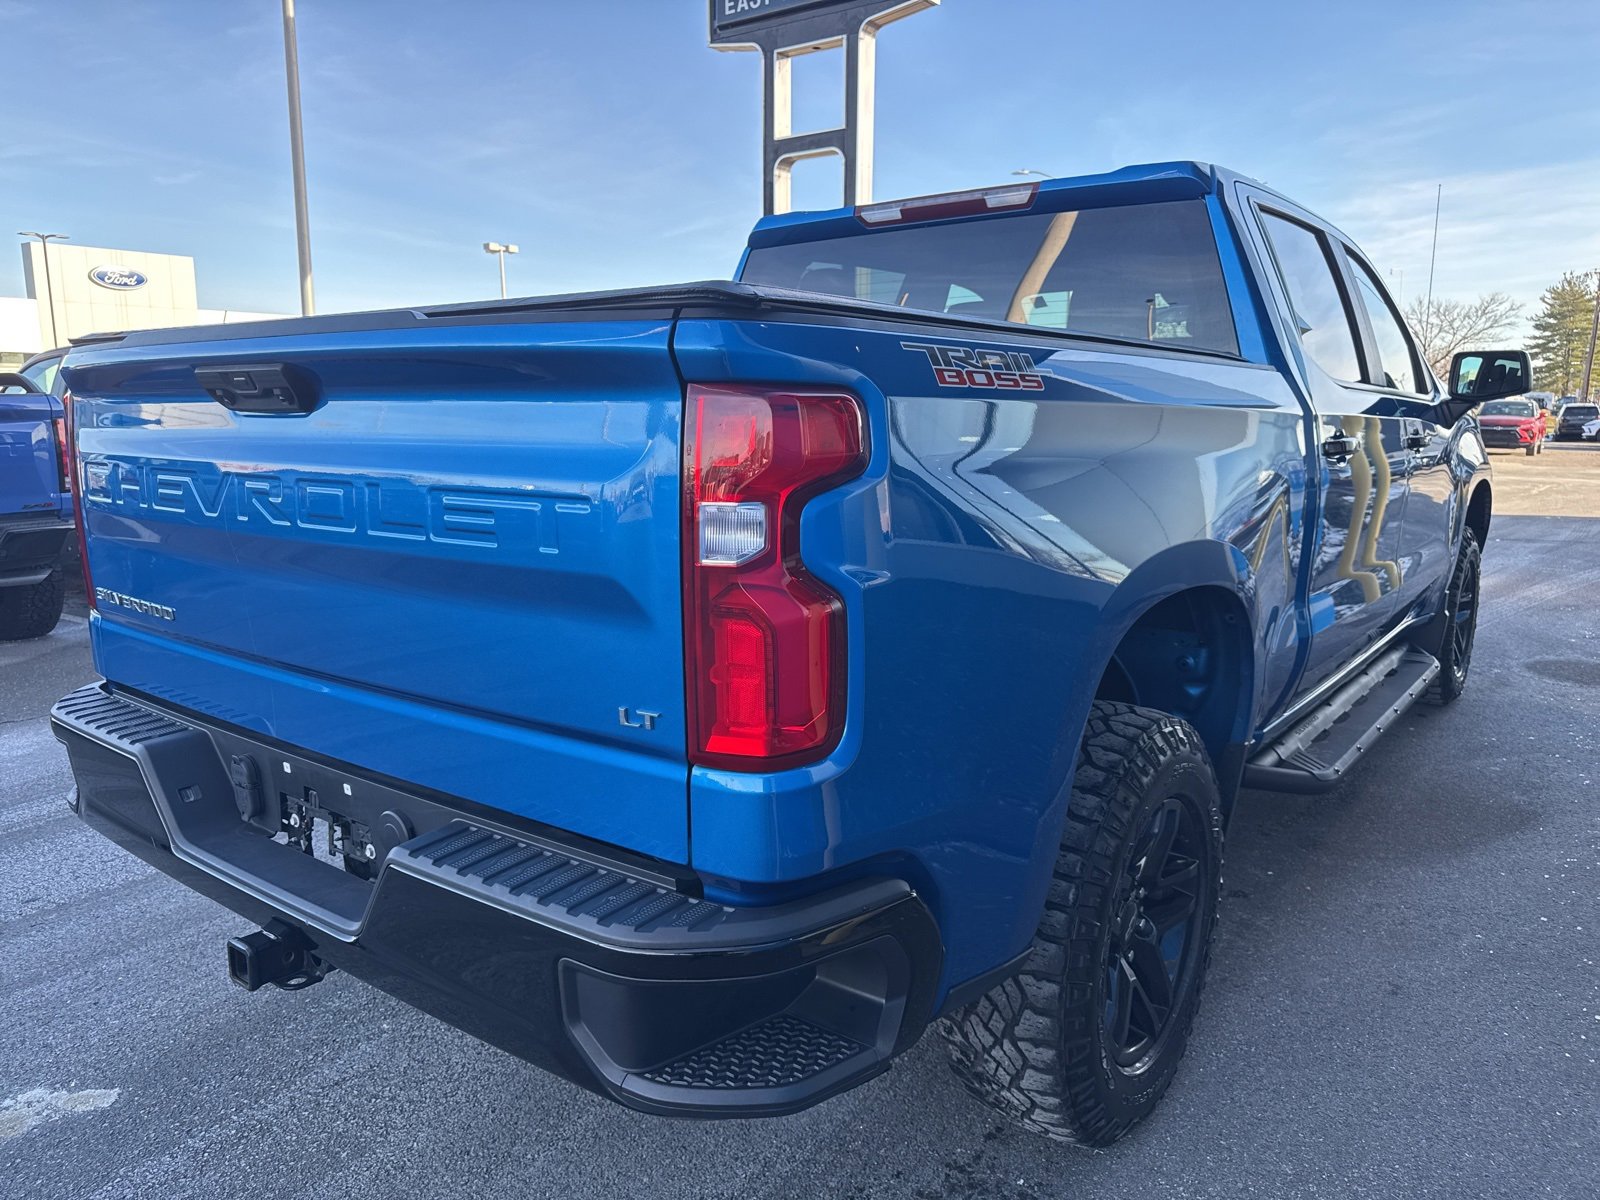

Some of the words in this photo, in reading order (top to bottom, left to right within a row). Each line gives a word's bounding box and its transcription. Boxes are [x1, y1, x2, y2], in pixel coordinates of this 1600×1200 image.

[725, 0, 769, 15] EA
[104, 270, 138, 285] Ford
[900, 341, 1053, 376] TRAIL
[933, 367, 1045, 392] BOSS
[84, 461, 591, 554] CHEVROLET
[95, 586, 176, 620] SILVERADO
[618, 705, 662, 731] LT
